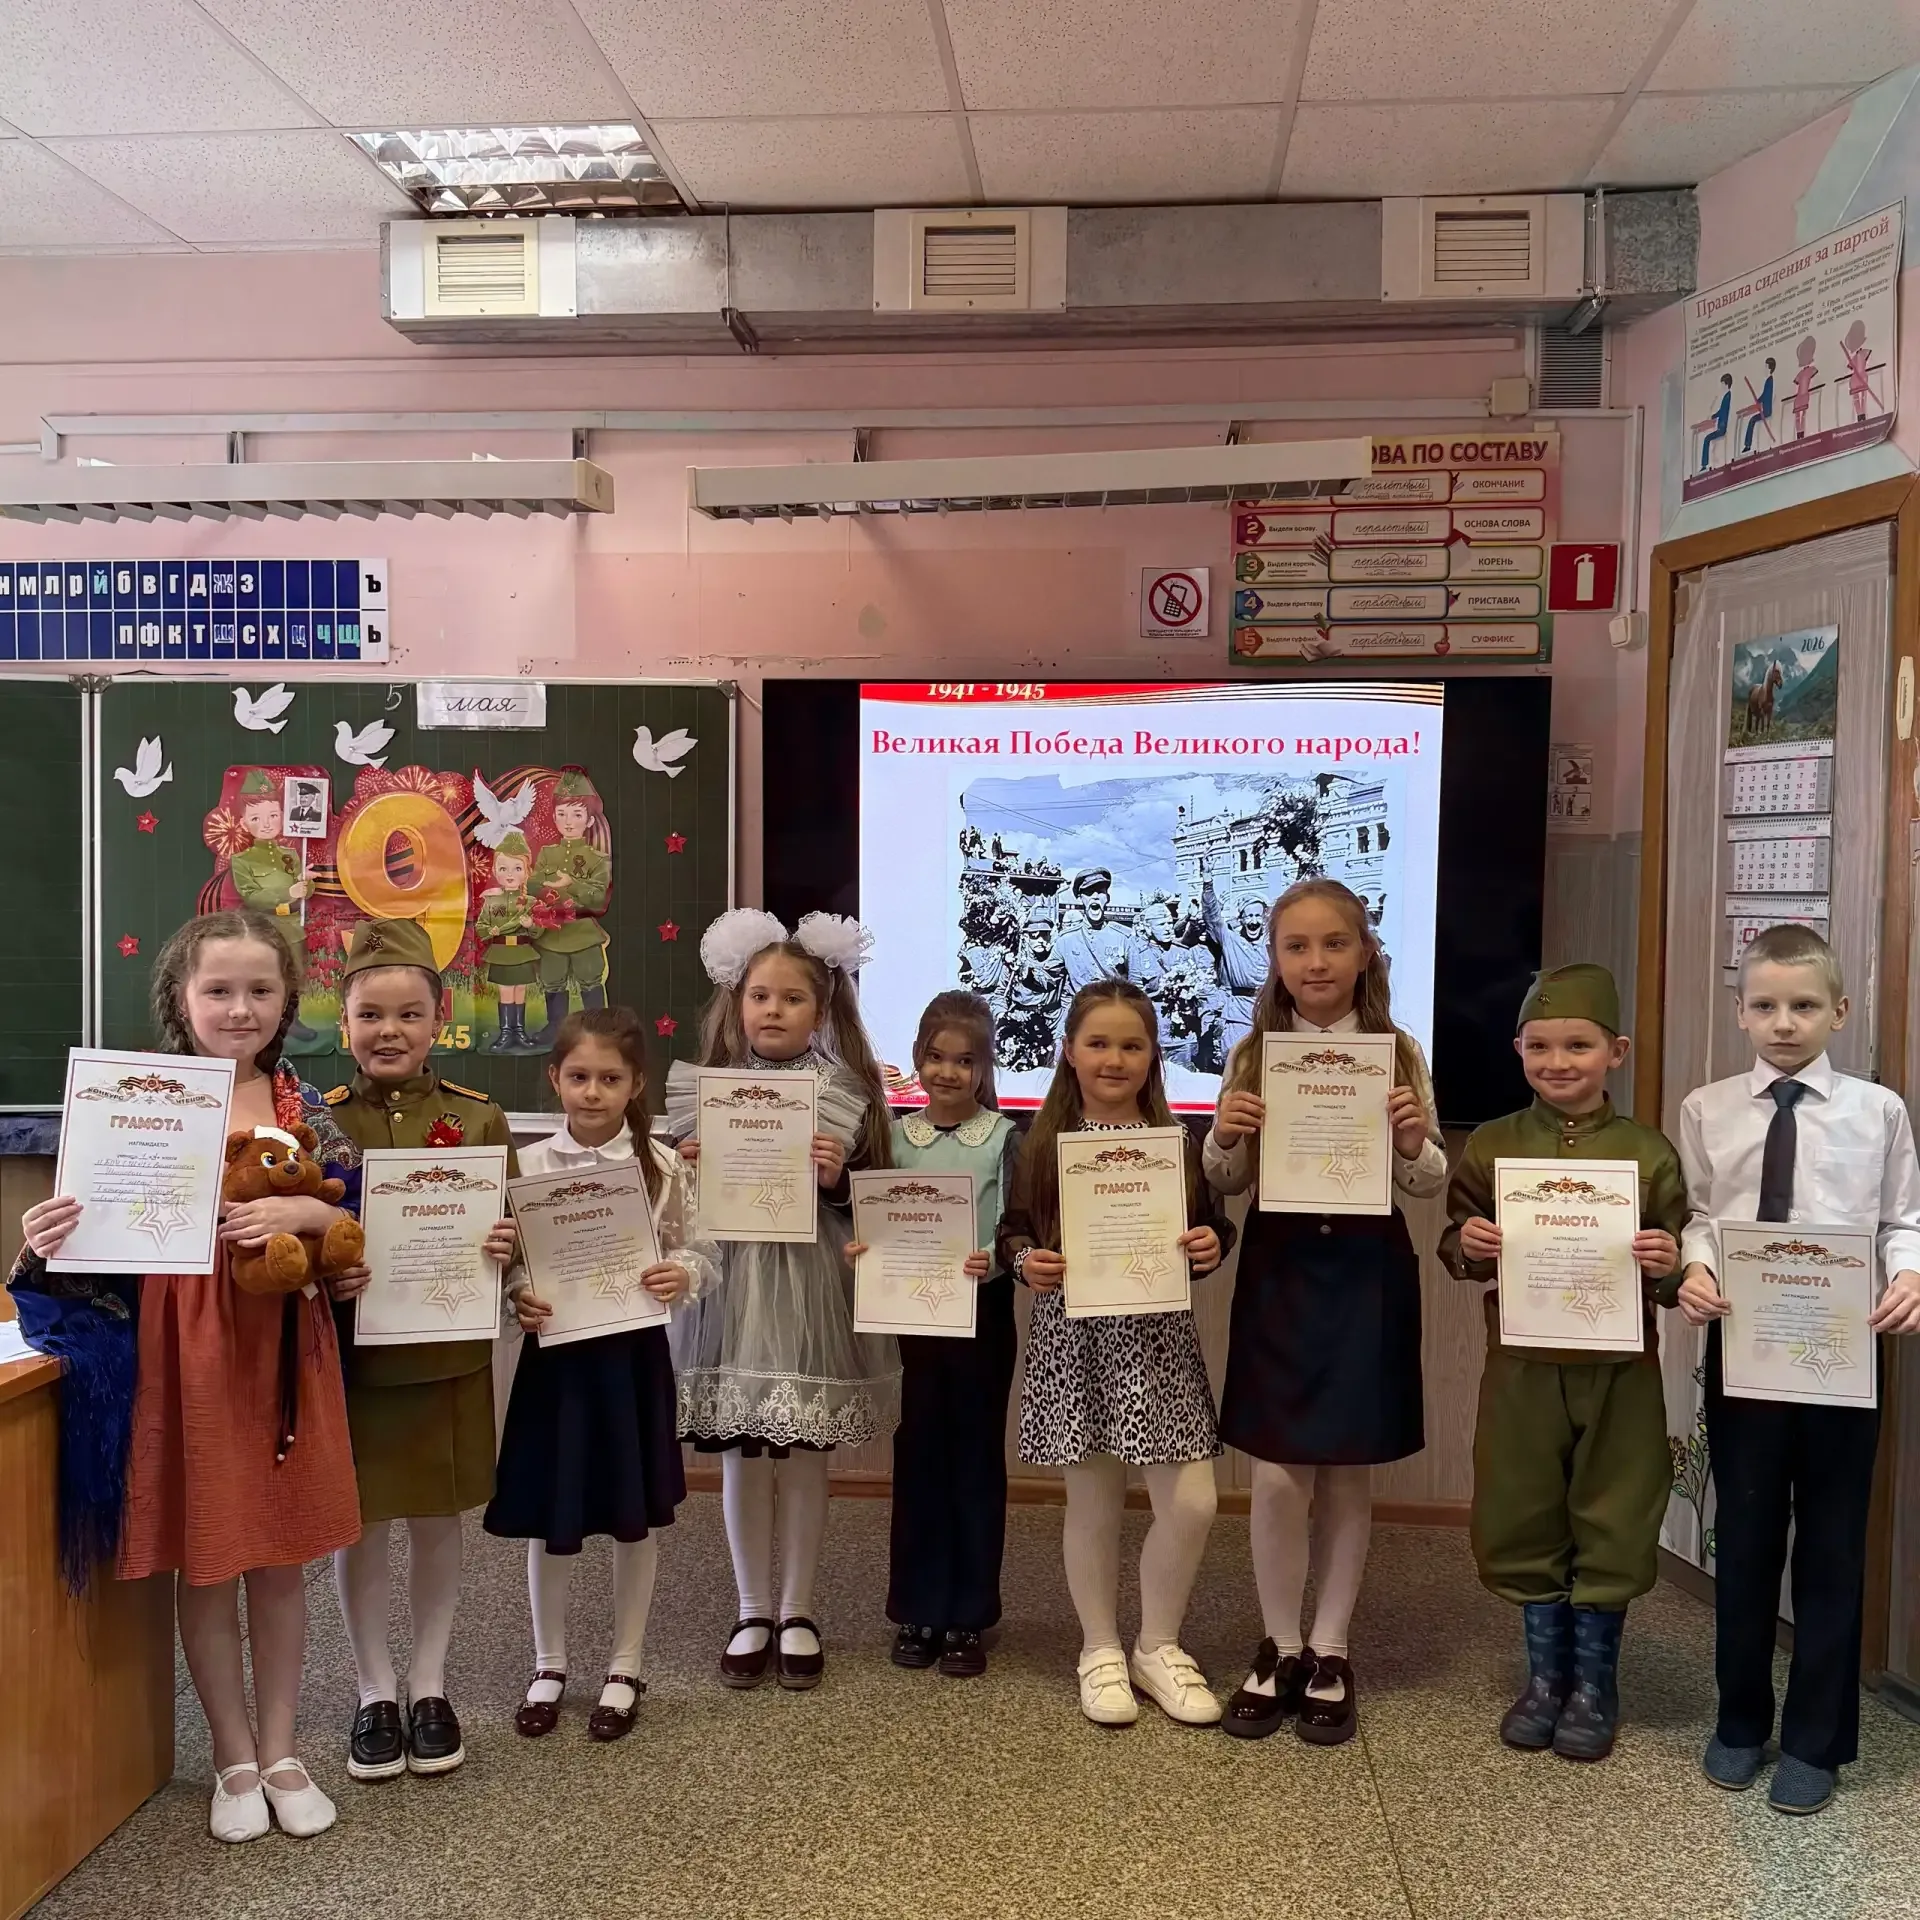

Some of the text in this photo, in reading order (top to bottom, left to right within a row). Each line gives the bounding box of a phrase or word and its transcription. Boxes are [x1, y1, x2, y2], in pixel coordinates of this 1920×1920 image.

[1696, 284, 1752, 319] Правила
[1755, 255, 1812, 292] сидения
[1815, 247, 1829, 264] за
[1833, 216, 1890, 256] партой
[1412, 443, 1444, 464] ПО
[1450, 441, 1549, 463] СОСТАВУ
[1472, 480, 1525, 489] ОКОНЧАНИЕ
[1247, 521, 1259, 534] 2
[1464, 519, 1531, 528] ОСНОВА СЛОВА
[1246, 559, 1258, 572] 3
[1478, 558, 1513, 566] КОРЕНЬ
[69, 575, 83, 597] р
[93, 569, 109, 595] й
[117, 570, 131, 594] б
[169, 574, 179, 594] г
[190, 574, 207, 597] д
[1244, 596, 1257, 609] 4
[1468, 597, 1521, 605] ПРИСТАВКА
[119, 625, 133, 645] п
[1244, 632, 1256, 645] 5
[1471, 635, 1515, 643] СУФФИКС
[928, 683, 975, 699] 1941
[995, 683, 1047, 699] 1945
[447, 697, 517, 712] мая
[872, 729, 1421, 761] Великая Победа Великого народа!
[87, 1087, 124, 1101] КОНКУРС
[1297, 1083, 1357, 1096] ГРАМОТА
[110, 1115, 184, 1132] ГРАМОТА
[729, 1118, 783, 1130] ГРАМОТА
[1094, 1181, 1150, 1195] ГРАМОТА
[402, 1203, 466, 1217] ГРАМОТА
[552, 1207, 614, 1226] ГРАМОТА
[887, 1212, 943, 1223] ГРАМОТА
[1534, 1214, 1599, 1228] ГРАМОТА
[1761, 1273, 1831, 1288] ГРАМОТА
